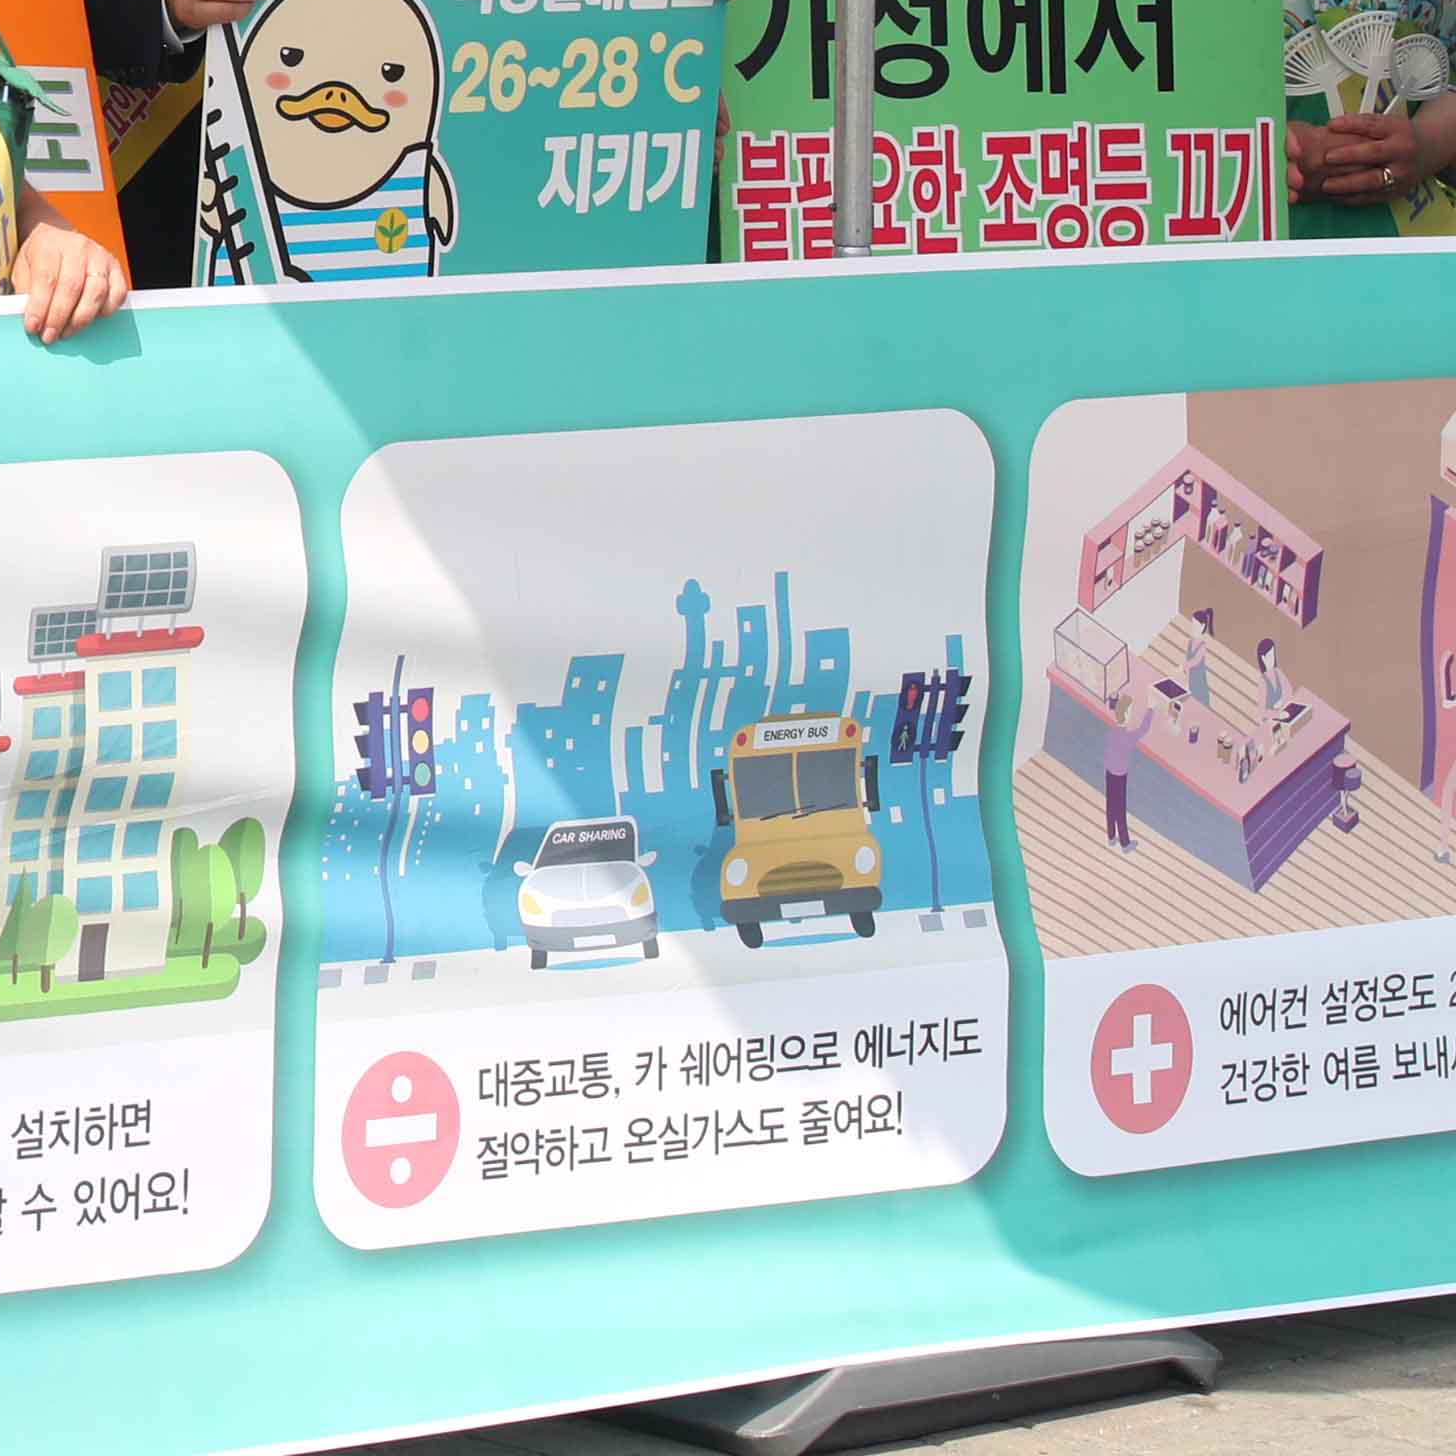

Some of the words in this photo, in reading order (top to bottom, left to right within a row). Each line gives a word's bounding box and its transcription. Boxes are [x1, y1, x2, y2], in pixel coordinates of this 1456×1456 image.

[537, 129, 701, 214] 지키기
[980, 121, 1151, 250] 조명등
[1167, 118, 1274, 242] 끄기
[763, 727, 806, 742] ENERGY
[807, 725, 829, 739] BUS
[552, 831, 576, 845] CAR
[578, 828, 627, 842] SHARING
[1220, 984, 1308, 1036] 에어컨
[1321, 973, 1438, 1025] 설정온도
[478, 1051, 622, 1108] 대중교통,
[634, 1046, 668, 1092] 카
[680, 1031, 842, 1087] 쉐어링으로
[854, 1017, 983, 1068] 에너지도
[1221, 1051, 1310, 1105] 건강한
[1323, 1044, 1381, 1091] 여름
[1392, 1034, 1456, 1080] 보내
[10, 1099, 151, 1160] 설치하면
[476, 1124, 613, 1180] 절약하고
[623, 1107, 789, 1165] 온실가스도
[799, 1090, 903, 1146] 줄여요!
[22, 1183, 57, 1231] 수
[73, 1167, 190, 1227] 있어요!
